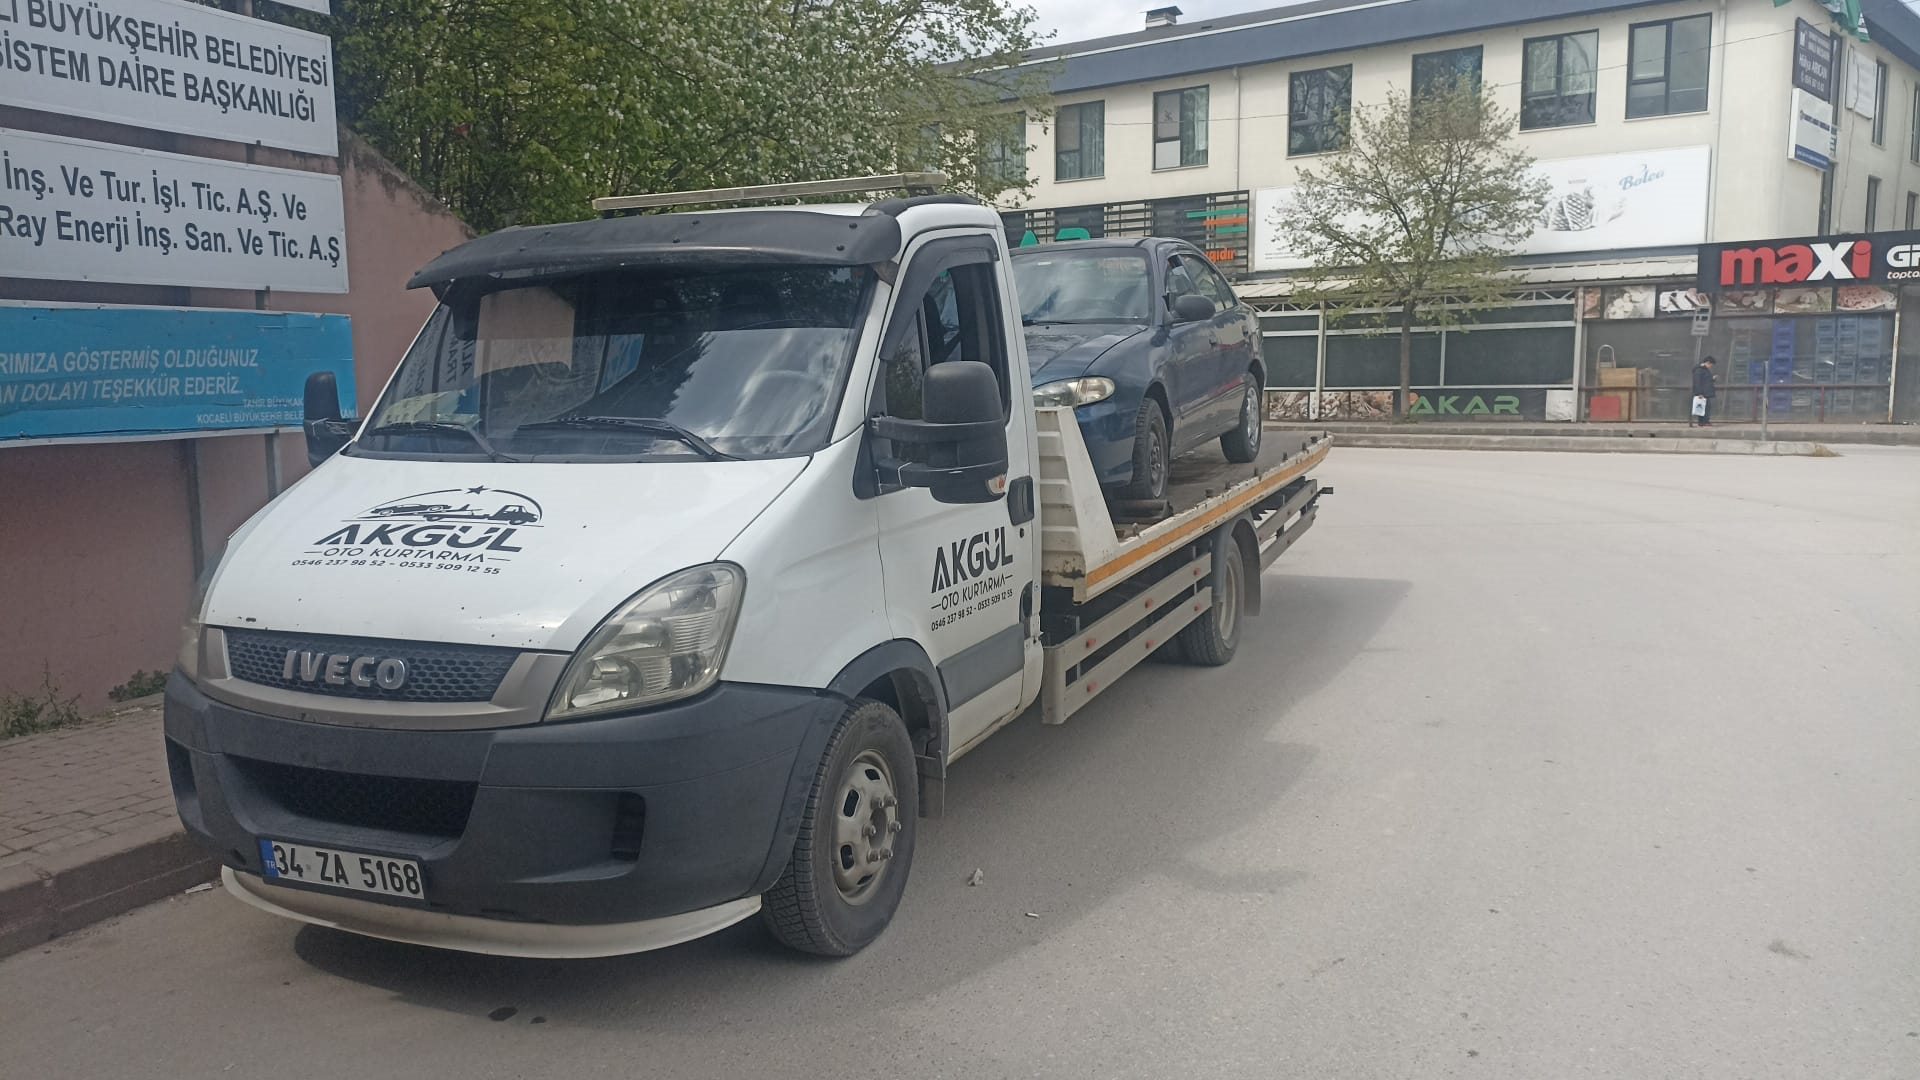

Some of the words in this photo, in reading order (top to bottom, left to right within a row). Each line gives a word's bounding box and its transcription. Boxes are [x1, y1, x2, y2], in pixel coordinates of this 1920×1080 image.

[0, 30, 90, 82] İSTEM
[98, 55, 177, 98] DAİRE
[183, 72, 316, 122] BAŞKANLIĞI
[205, 34, 328, 87] BELEDİYESİ
[4, 151, 54, 200] İnş.
[60, 165, 94, 198] Ve
[100, 170, 146, 203] Tur.
[152, 169, 186, 213] İşl.
[191, 181, 231, 212] Tic.
[236, 188, 278, 223] A.Ş.
[282, 193, 307, 221] Ve
[0, 205, 46, 247] Ray
[55, 210, 129, 252] Enerji
[136, 211, 178, 255] İnş.
[185, 222, 232, 253] San.
[237, 227, 264, 256] Ve
[268, 230, 303, 259] Tic.
[309, 234, 340, 268] A.Ş
[63, 345, 160, 372] GÖSTERMİŞ
[164, 345, 259, 369] OLDUĞUNUZ
[0, 384, 18, 404] N
[20, 381, 88, 402] DOLAYI
[92, 373, 180, 402] TEŞEKKÜR
[1409, 395, 1520, 414] AKAR
[313, 524, 522, 552] AKGÜL
[323, 548, 364, 557] OTO
[369, 548, 485, 562] KURTARMA
[399, 561, 432, 569] 0533
[436, 563, 462, 571] 509
[484, 567, 501, 575] 55
[931, 526, 1013, 593] AKGÜL
[931, 617, 946, 631] 0546
[947, 613, 957, 625] 237
[966, 606, 973, 616] 52
[977, 600, 990, 611] 0533
[991, 594, 1001, 605] 509
[1001, 591, 1006, 600] 12
[1007, 589, 1013, 597] 55
[941, 591, 959, 610] OTO
[963, 573, 1005, 603] KURTARMA
[283, 650, 407, 690] IVECO
[265, 860, 275, 868] TR
[273, 845, 304, 877] 34
[315, 851, 349, 884] ZA
[359, 857, 421, 894] 5168
